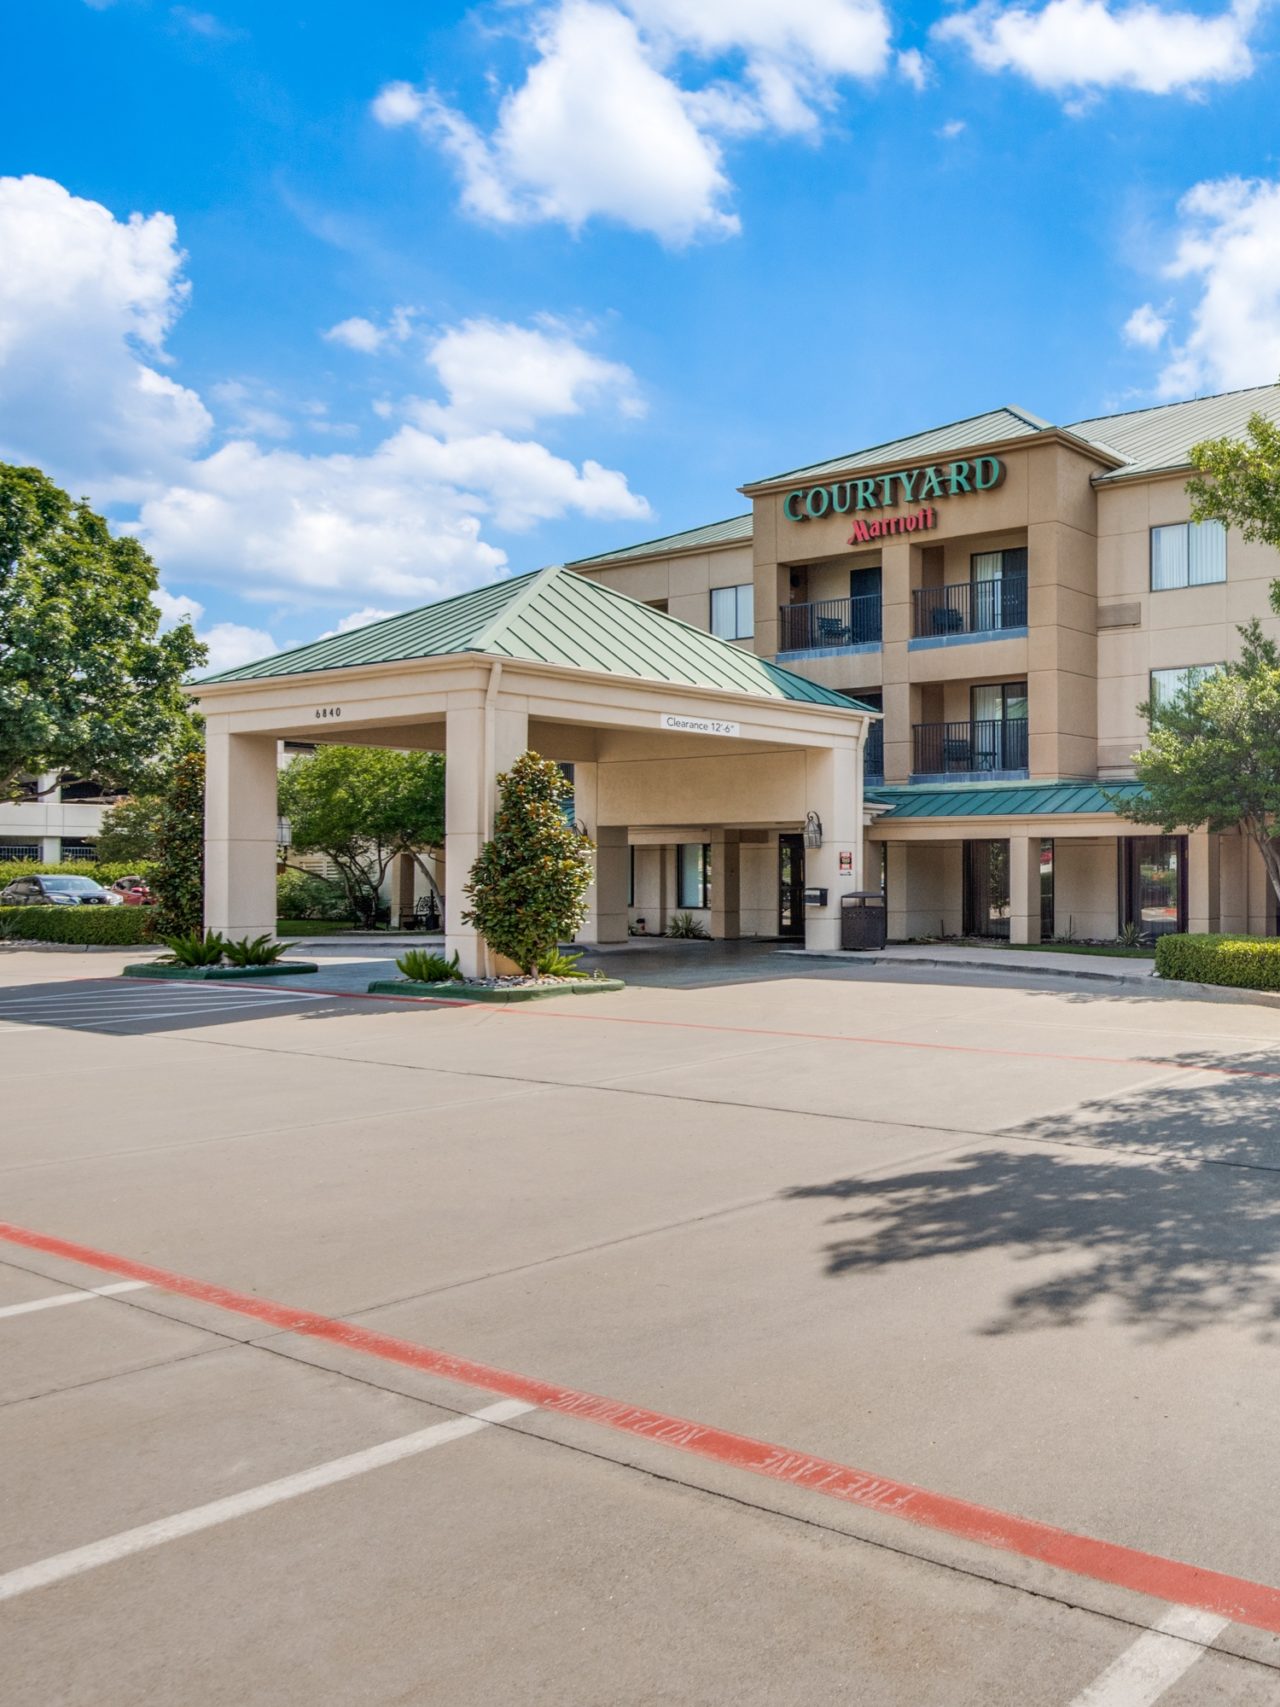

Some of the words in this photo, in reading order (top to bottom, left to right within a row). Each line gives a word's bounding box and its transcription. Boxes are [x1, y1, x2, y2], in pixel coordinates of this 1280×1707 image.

[783, 456, 1002, 521] COURTYARD
[847, 507, 935, 545] Marriott
[315, 707, 341, 719] 6840
[666, 716, 708, 731] Clearance
[543, 1390, 668, 1432] PARKING
[654, 1422, 708, 1444] NO
[748, 1450, 845, 1487] LANE
[831, 1474, 917, 1509] FIRE
